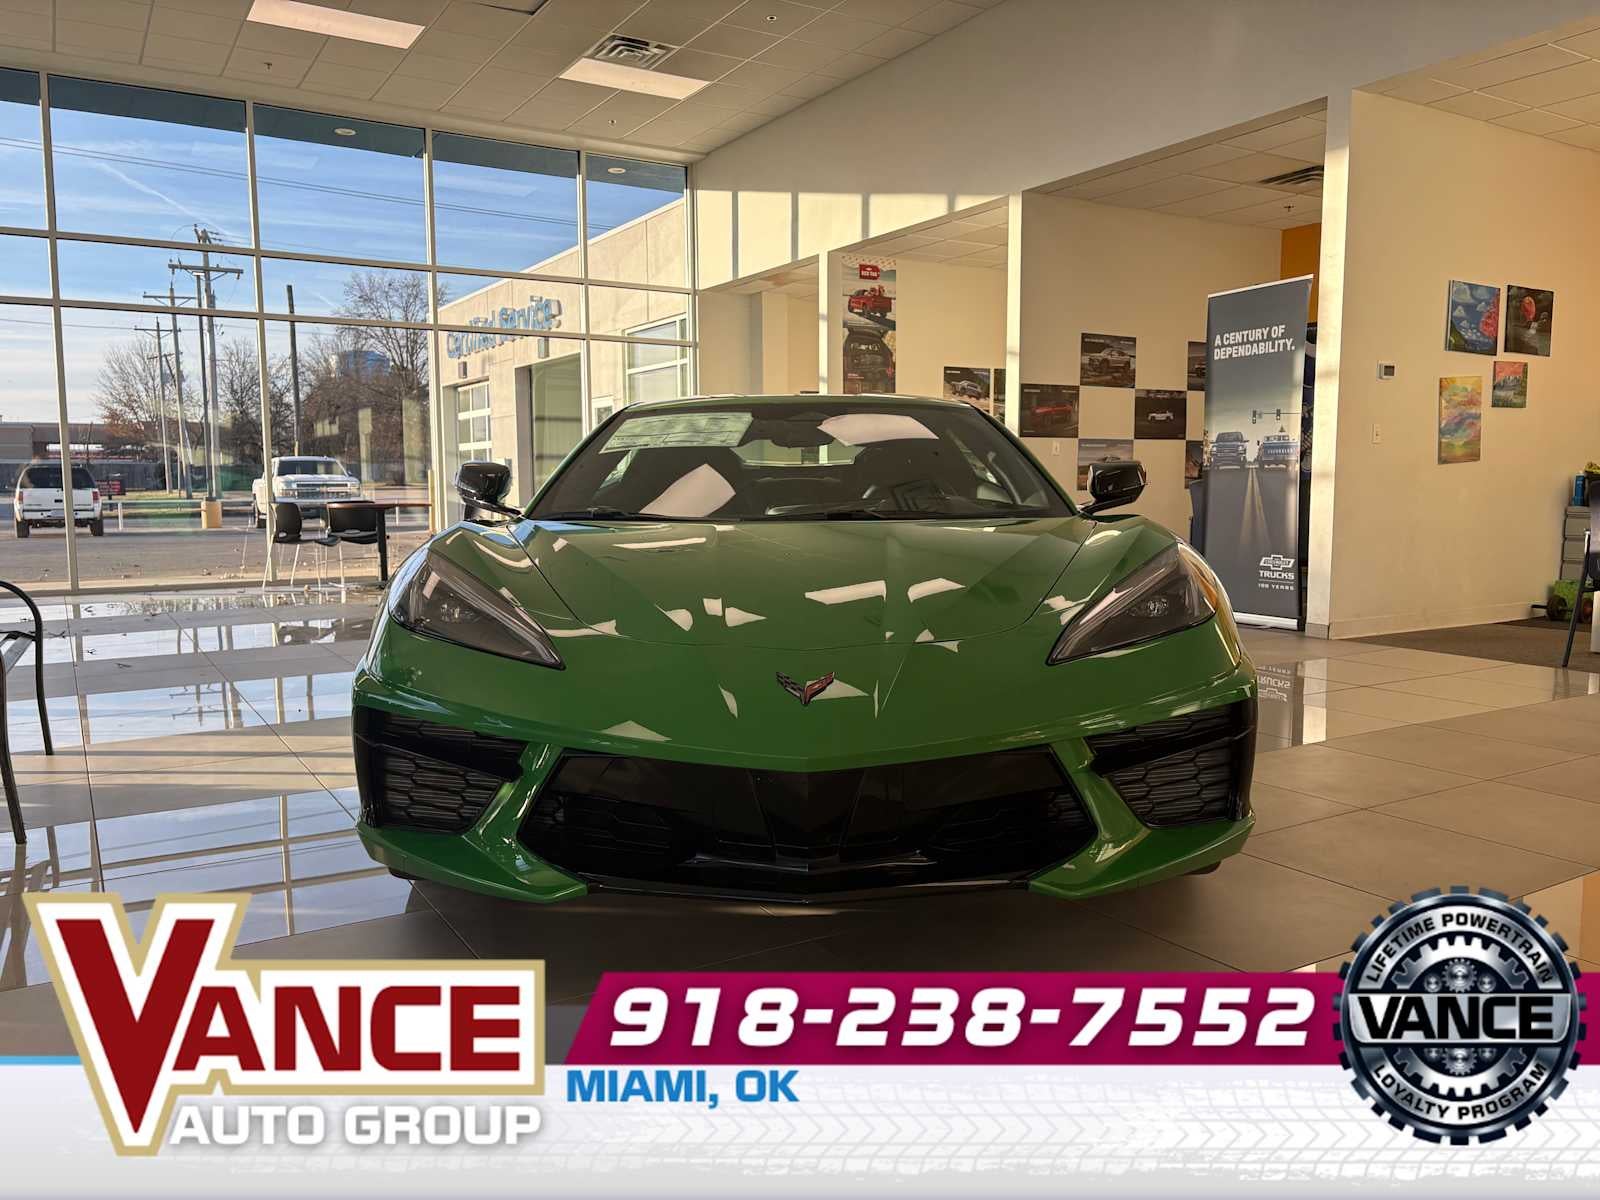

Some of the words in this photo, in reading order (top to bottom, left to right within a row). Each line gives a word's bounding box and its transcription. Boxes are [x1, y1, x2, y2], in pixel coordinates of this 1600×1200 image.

[499, 296, 562, 346] Service
[1214, 334, 1221, 346] A
[1223, 327, 1270, 345] CENTURY
[1271, 325, 1286, 338] OF
[1213, 338, 1296, 360] DEPENDABILITY.
[1259, 570, 1295, 580] TRUCKS
